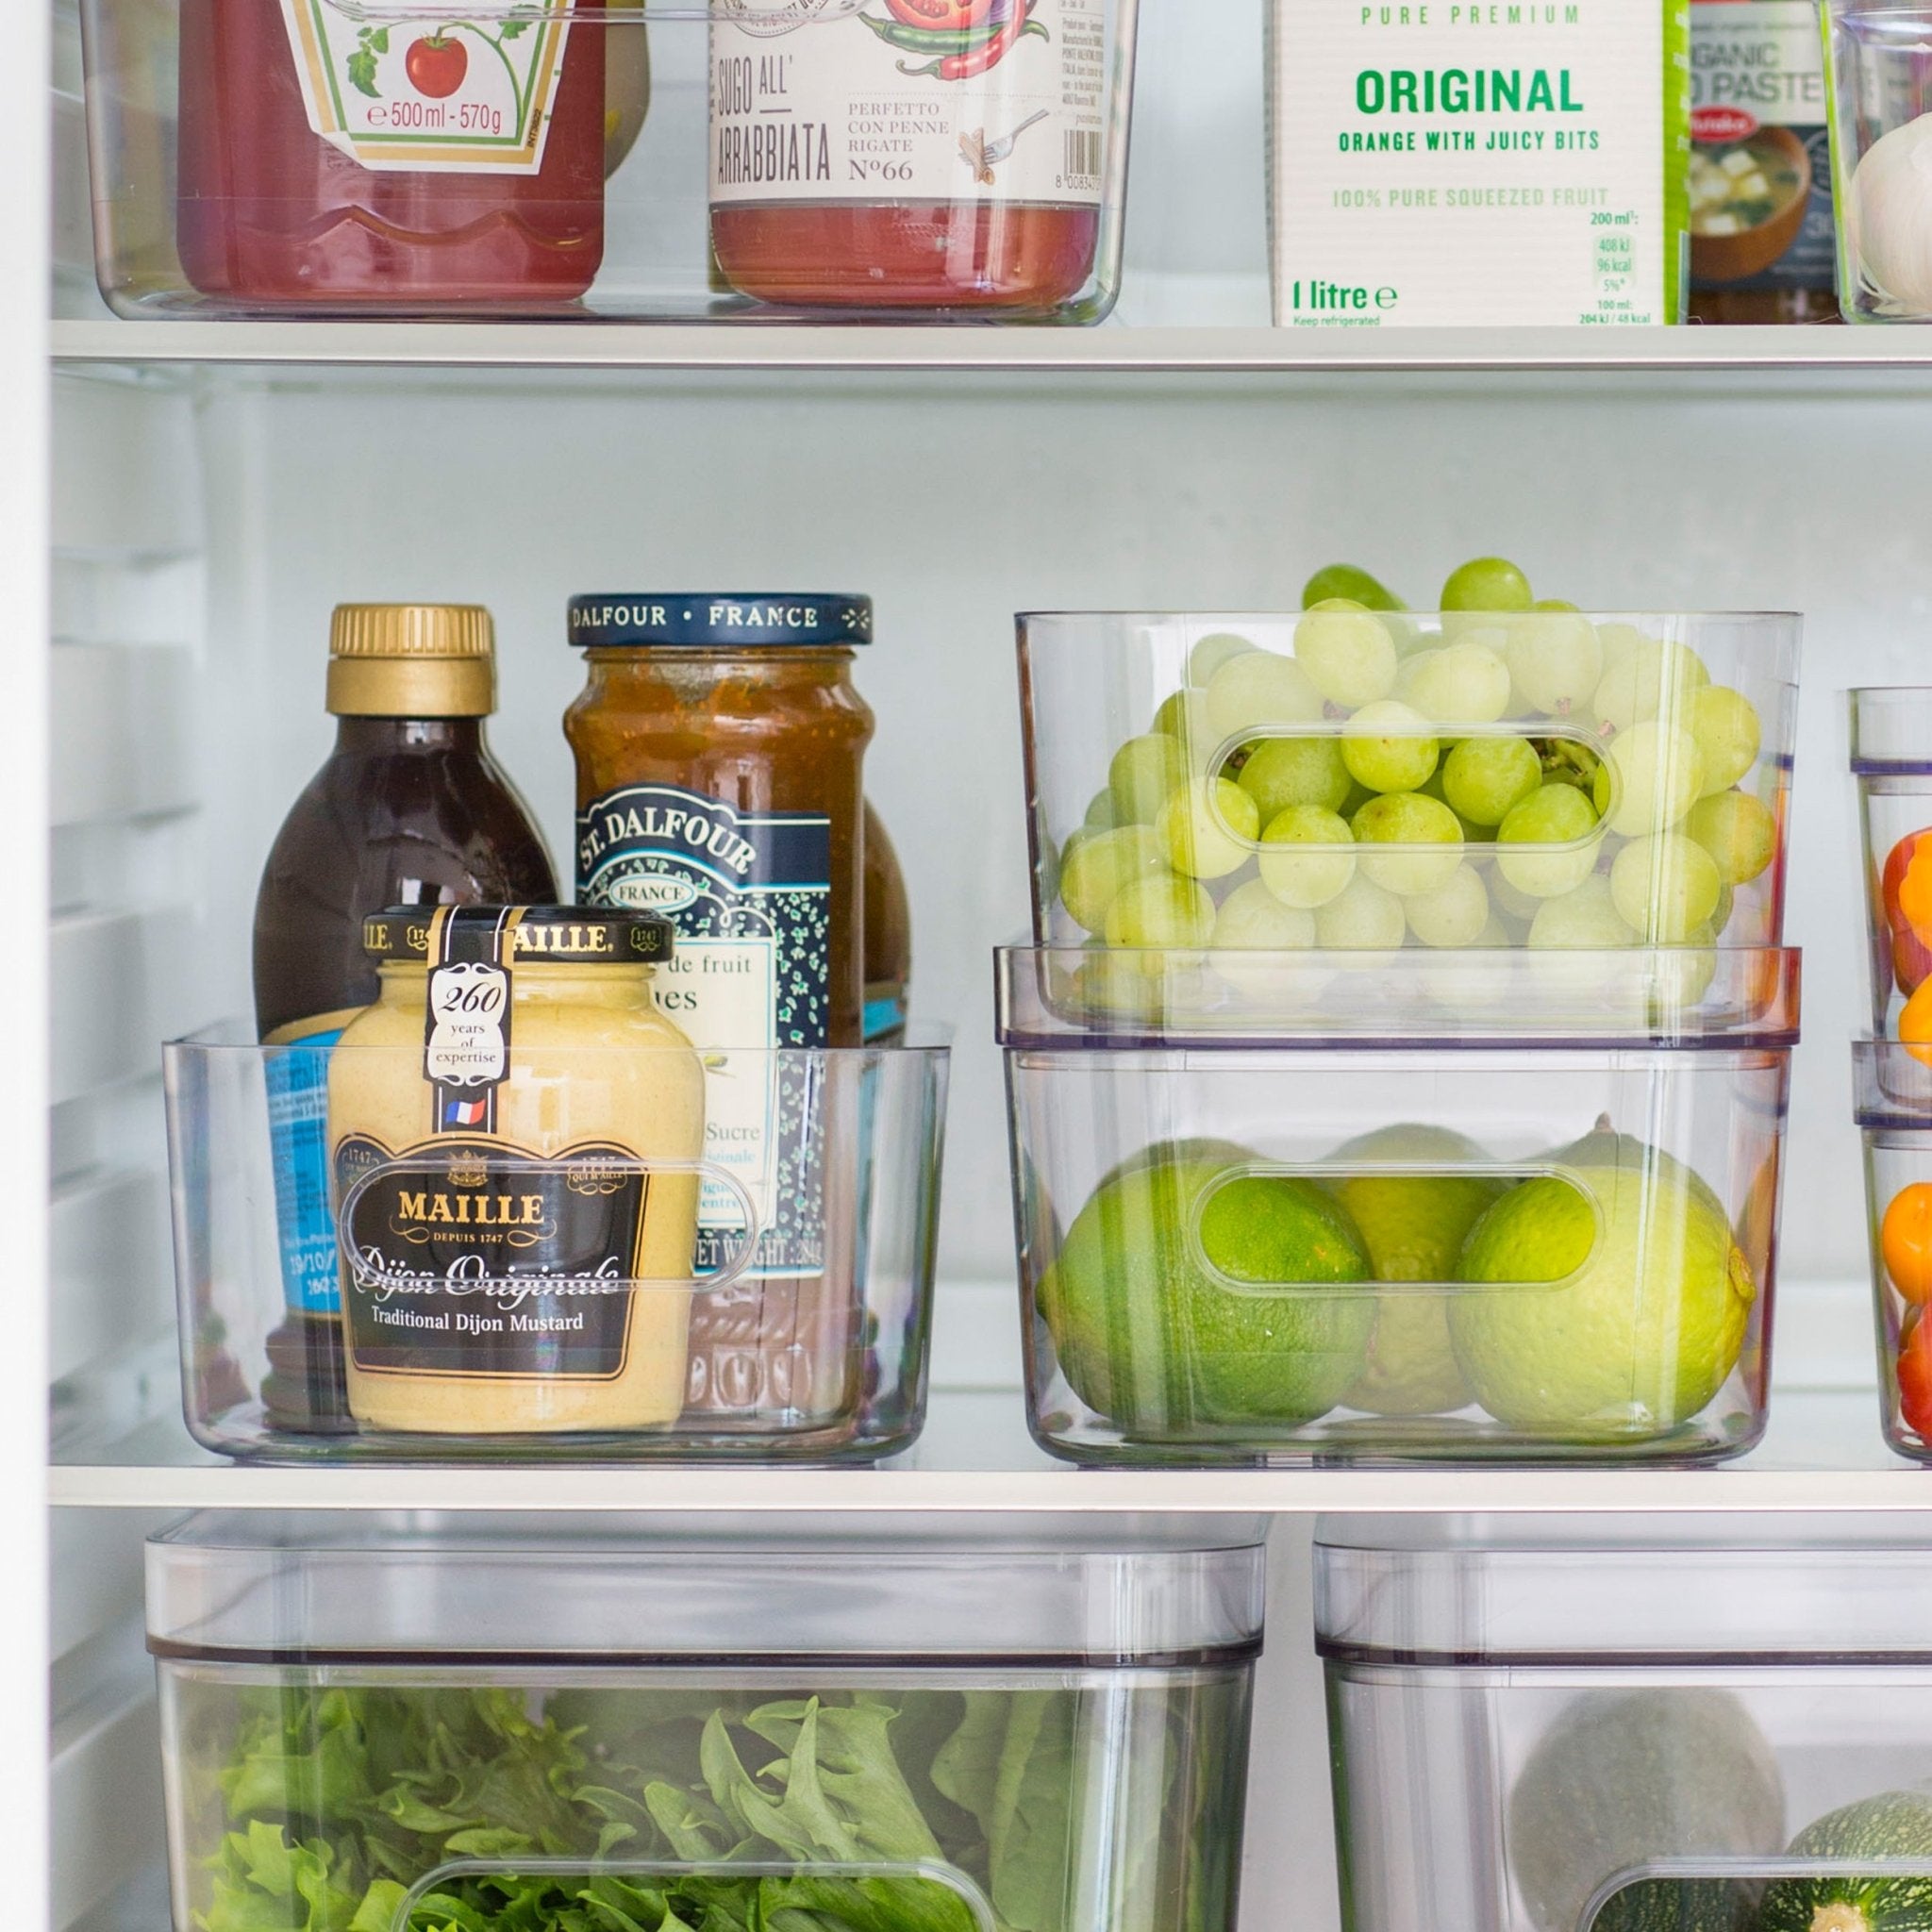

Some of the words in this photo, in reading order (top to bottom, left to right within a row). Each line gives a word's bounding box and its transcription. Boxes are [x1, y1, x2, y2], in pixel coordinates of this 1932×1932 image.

[1361, 6, 1429, 25] PURE
[1451, 5, 1579, 25] PREMIUM
[719, 57, 753, 117] SUGO
[1357, 69, 1584, 113] ORIGINAL
[1711, 73, 1824, 103] PASTE
[848, 103, 940, 116] PERFETTO
[848, 121, 885, 134] CON
[890, 121, 949, 134] PENNE
[848, 140, 913, 152] RIGATE
[1340, 132, 1416, 151] ORANGE
[1427, 131, 1475, 151] WITH
[1486, 131, 1545, 150] JUICY
[1556, 131, 1600, 150] BITS
[718, 123, 830, 185] ARRABBIATA
[1333, 191, 1381, 208] 100%
[1390, 190, 1438, 208] PURE
[1446, 189, 1544, 207] SQUEEZED
[1553, 189, 1608, 207] FRUIT
[1591, 212, 1612, 225] 200
[1597, 258, 1610, 272] 96
[1612, 258, 1631, 272] kcal
[1310, 280, 1368, 309] litre
[1598, 300, 1614, 309] 100
[1293, 316, 1318, 326] Keep
[1321, 316, 1380, 326] refrigerated
[1631, 312, 1651, 323] kcal
[572, 606, 667, 627] DALFOUR
[709, 606, 818, 627] FRANCE
[579, 832, 607, 870] ST.
[608, 807, 757, 874] DALFOUR
[619, 887, 685, 901] FRANCE
[668, 955, 692, 973] de
[703, 955, 751, 973] fruit
[440, 981, 502, 1013] 260
[451, 1024, 486, 1036] years
[460, 1038, 475, 1048] of
[436, 1052, 496, 1065] expertise
[706, 1123, 760, 1141] Sucre
[349, 1147, 372, 1164] 1747
[398, 1191, 545, 1225] MAILLE
[433, 1232, 476, 1243] DEPUIS
[480, 1233, 504, 1243] 1747
[353, 1245, 439, 1302] Dijon
[371, 1306, 450, 1330] Traditional
[456, 1313, 504, 1336] Dijon
[510, 1312, 584, 1331] Mustard
